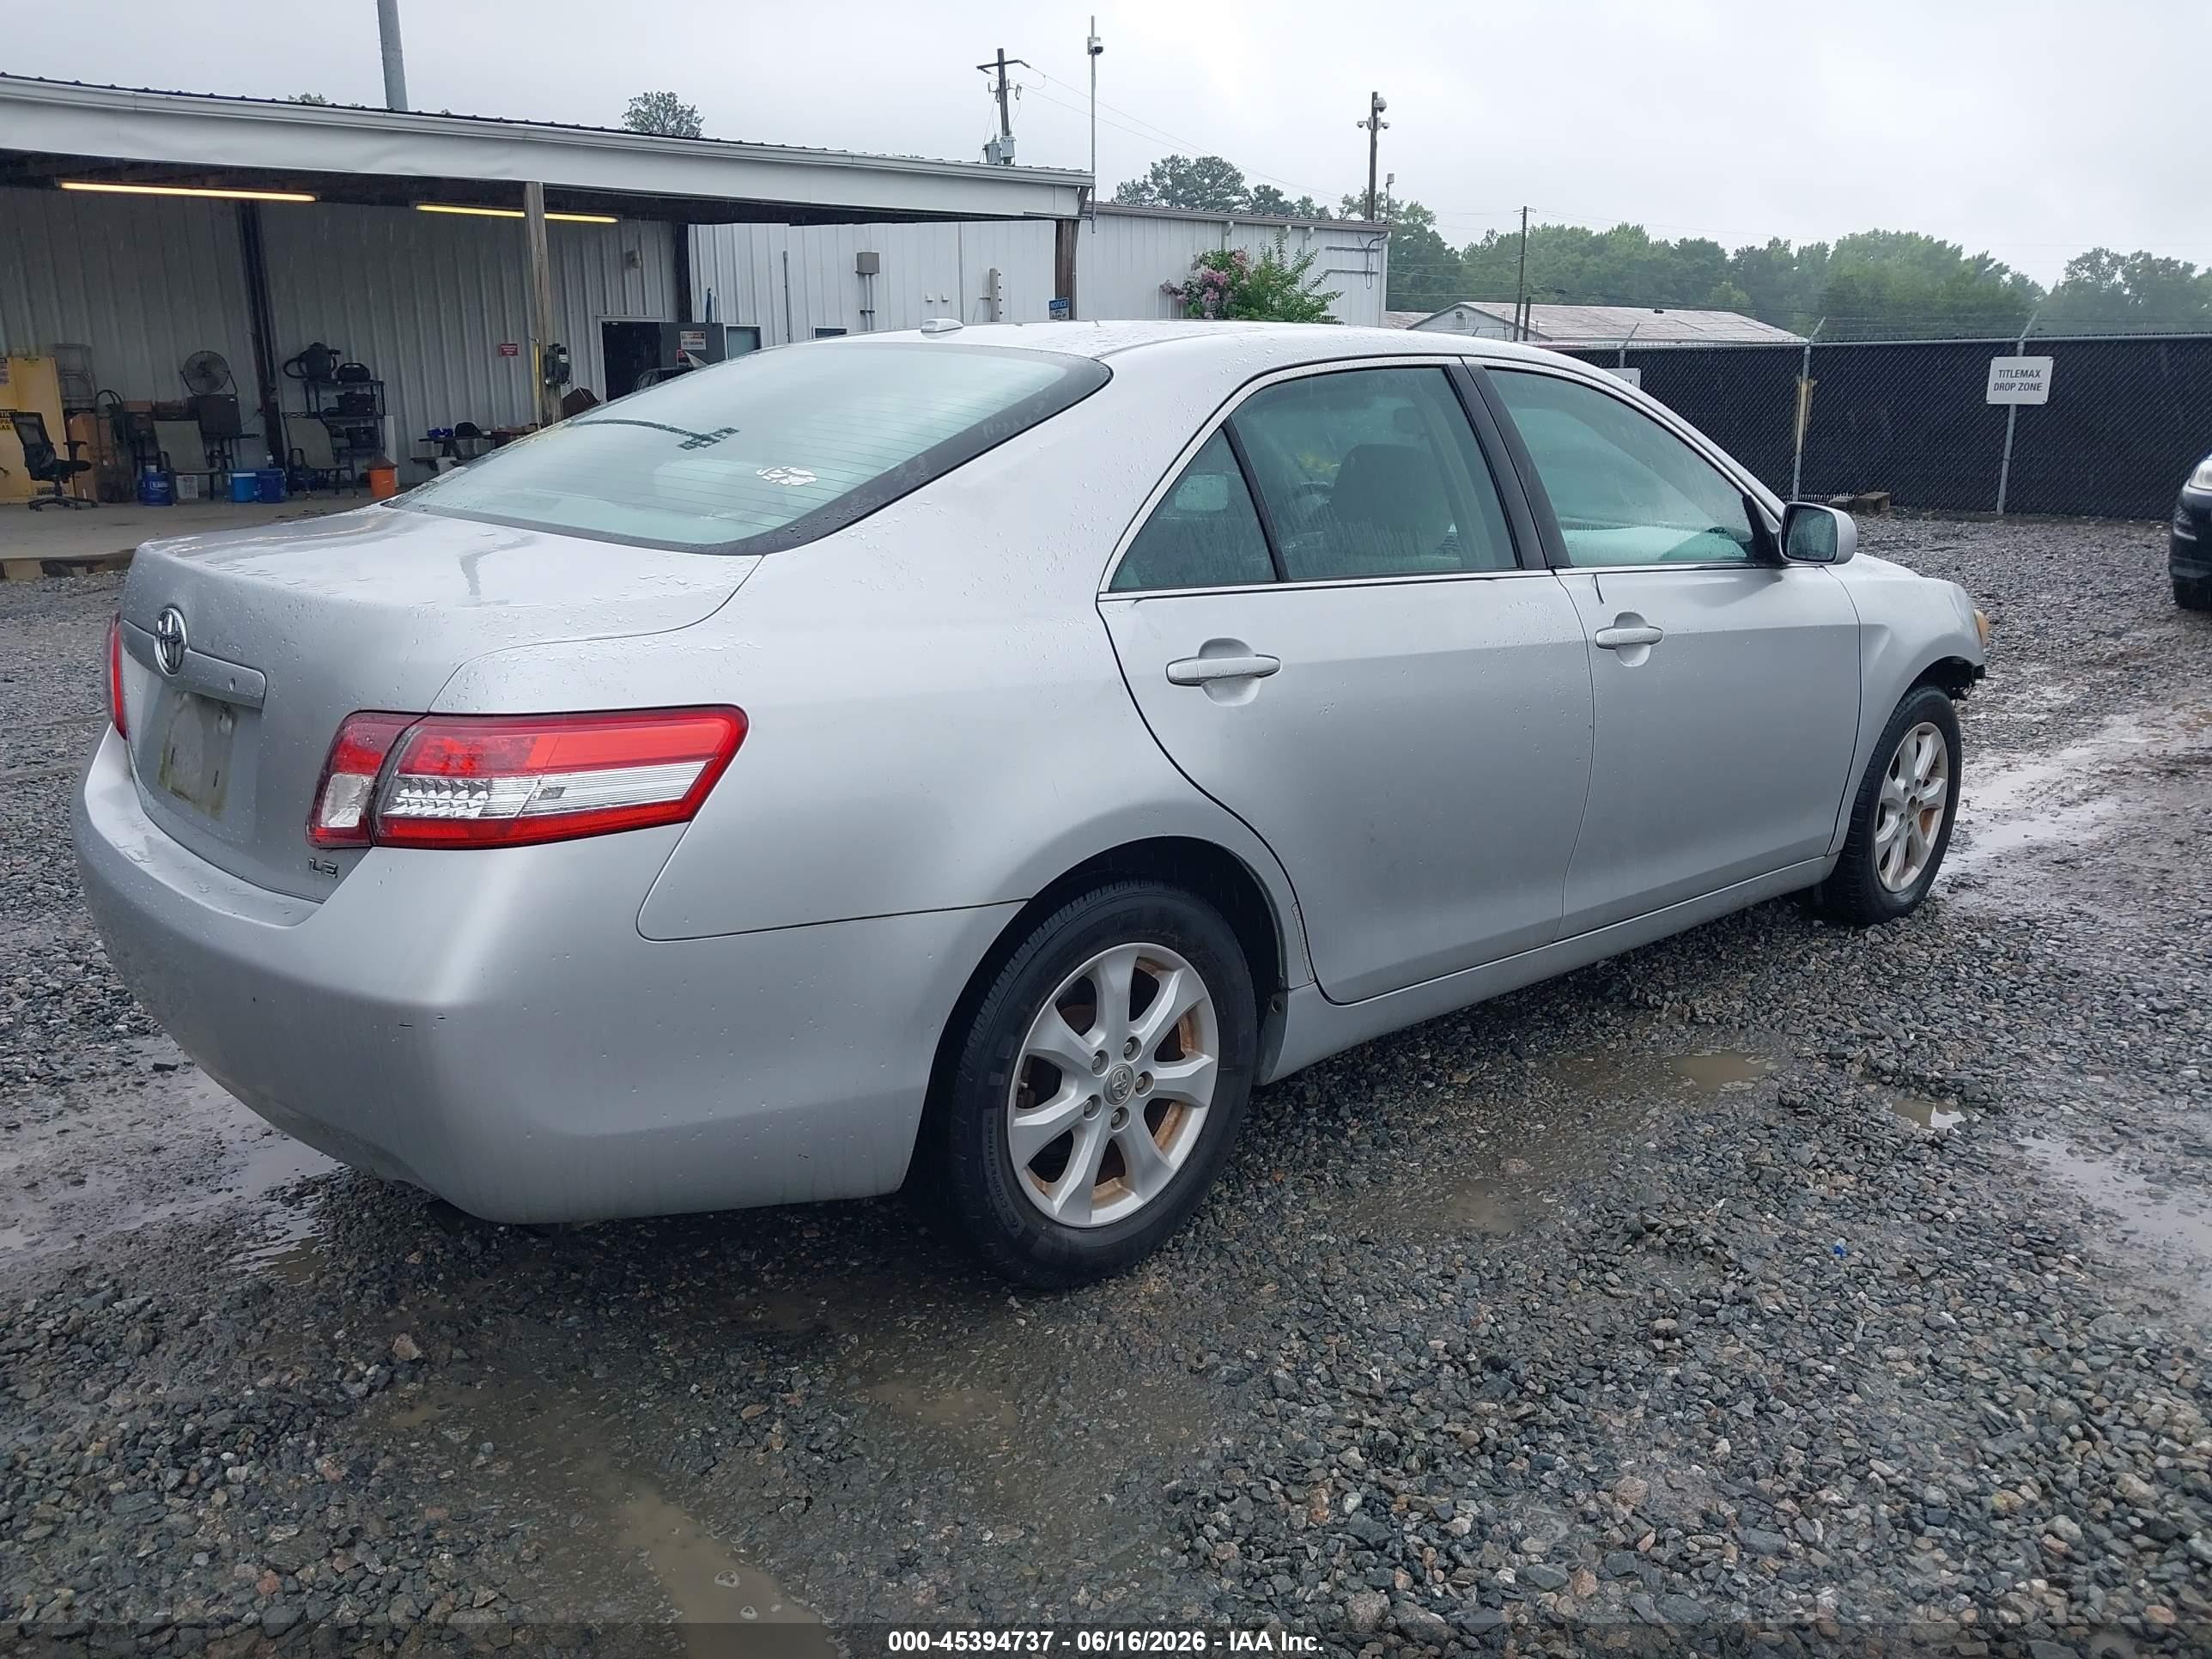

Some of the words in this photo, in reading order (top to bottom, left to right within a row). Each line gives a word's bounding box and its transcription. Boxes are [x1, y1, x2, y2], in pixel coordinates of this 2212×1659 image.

[1049, 300, 1067, 310] NOTICE
[1998, 369, 2042, 379] TITLEMAX
[1993, 382, 2016, 392] DROP
[2017, 382, 2044, 392] ZONE
[309, 858, 338, 878] LE
